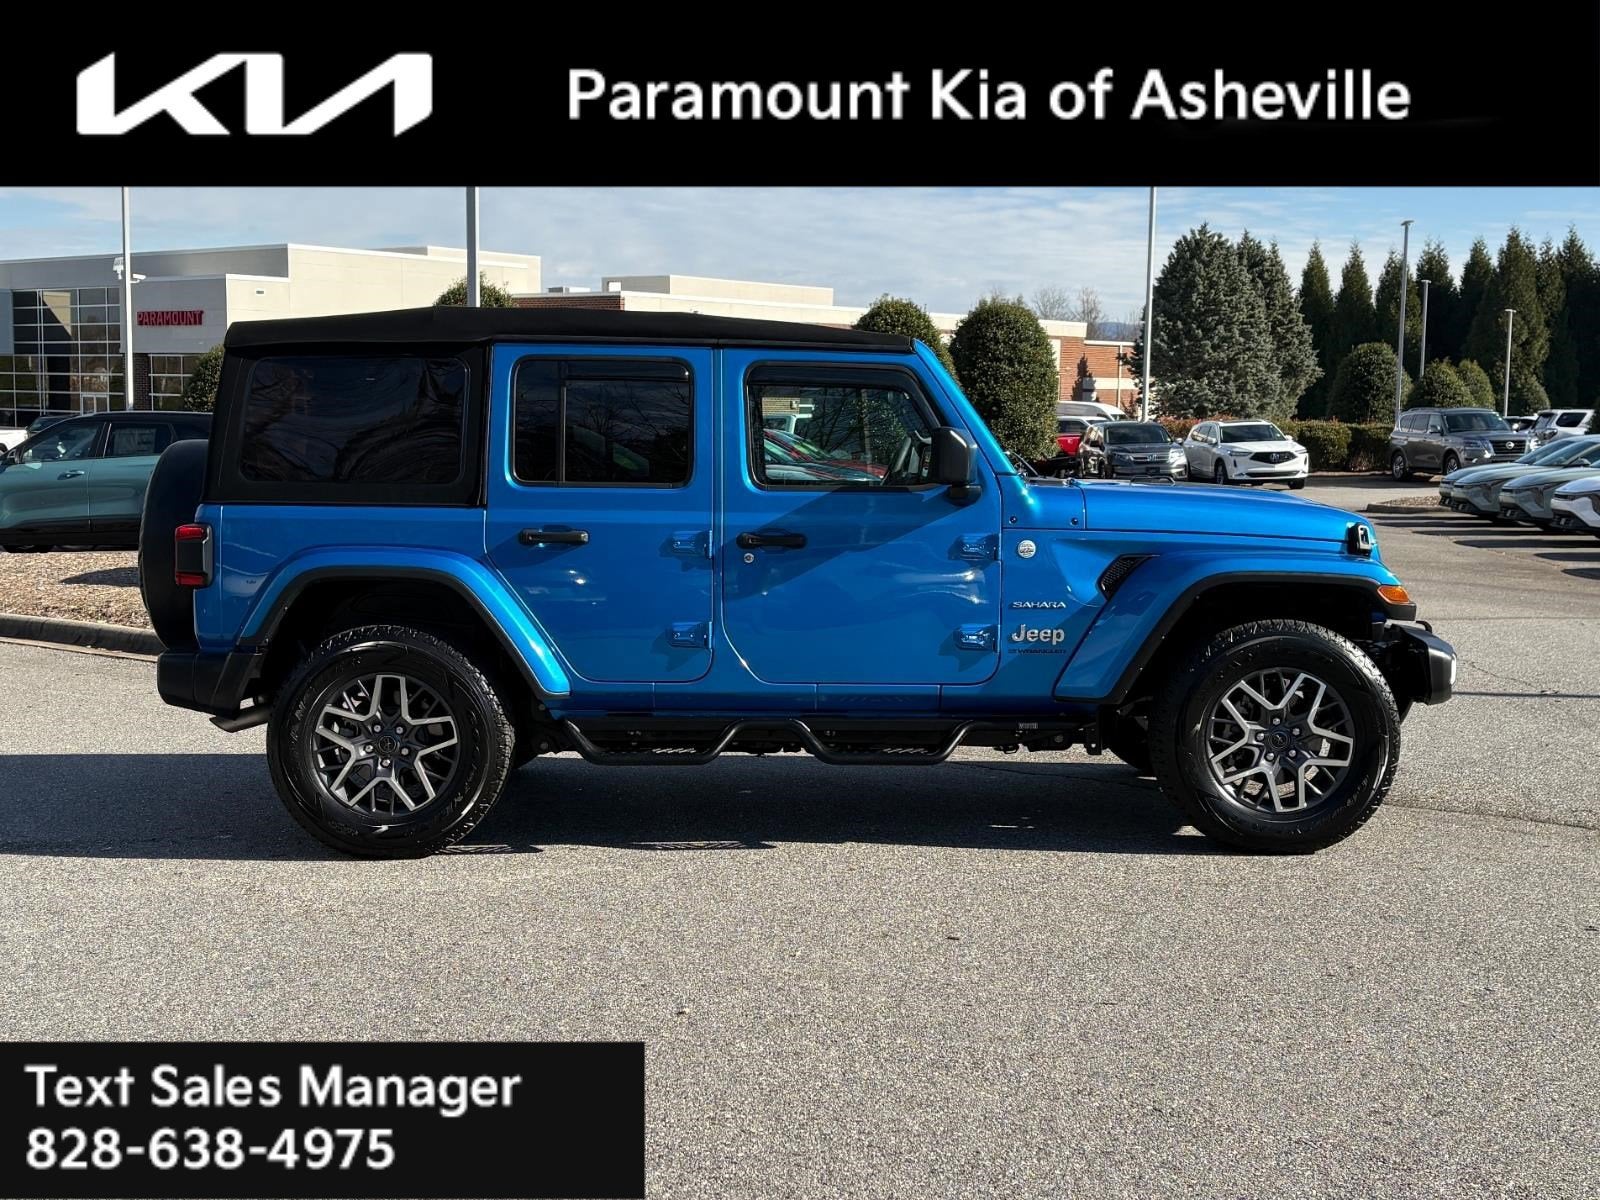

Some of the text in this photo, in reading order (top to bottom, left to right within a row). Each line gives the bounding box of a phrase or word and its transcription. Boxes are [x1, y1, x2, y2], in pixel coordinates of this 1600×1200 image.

[136, 310, 205, 326] PARAMOUNT
[1011, 600, 1068, 609] SAHARA
[1011, 623, 1066, 645] Jeep
